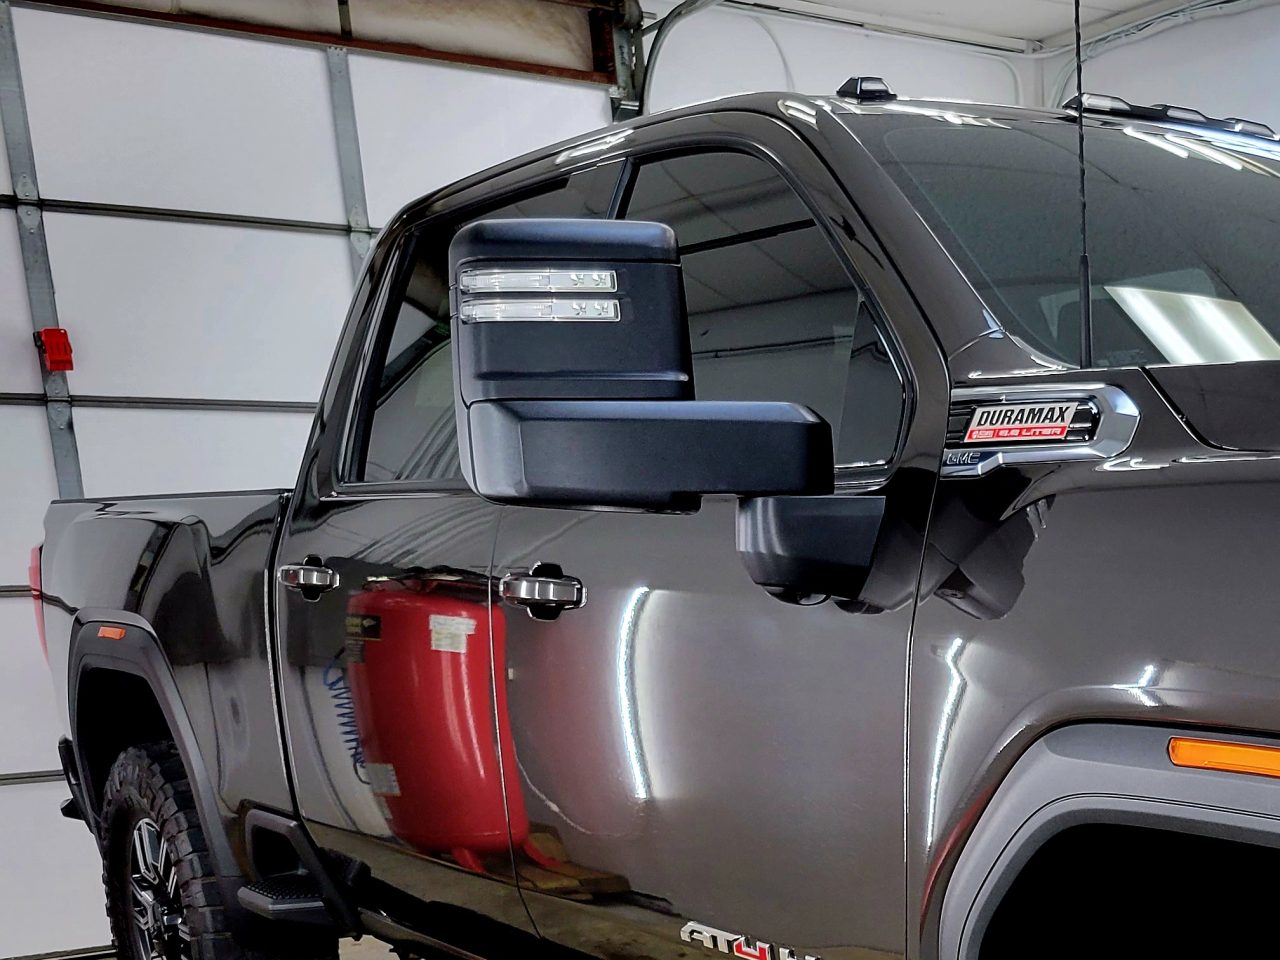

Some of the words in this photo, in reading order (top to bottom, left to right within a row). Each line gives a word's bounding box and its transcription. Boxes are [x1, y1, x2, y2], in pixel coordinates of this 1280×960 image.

[976, 406, 1071, 426] DURAMAX
[1021, 427, 1063, 437] LITER
[946, 452, 981, 465] GMC
